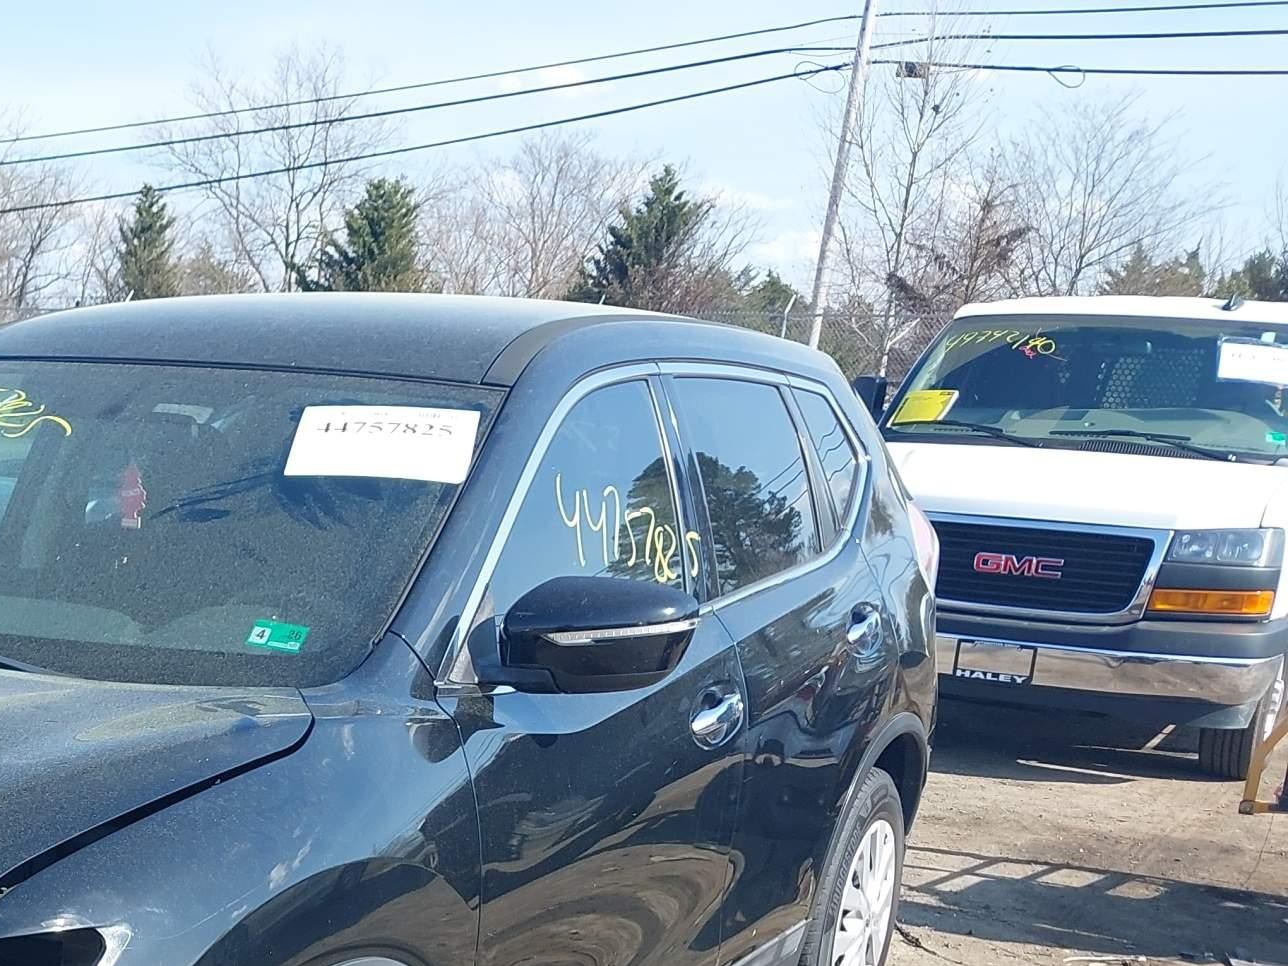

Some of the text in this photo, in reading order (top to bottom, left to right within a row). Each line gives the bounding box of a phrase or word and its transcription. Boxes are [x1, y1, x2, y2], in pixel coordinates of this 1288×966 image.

[316, 421, 453, 437] 44757825
[973, 552, 1065, 579] GMC
[955, 668, 1028, 685] HALEY
